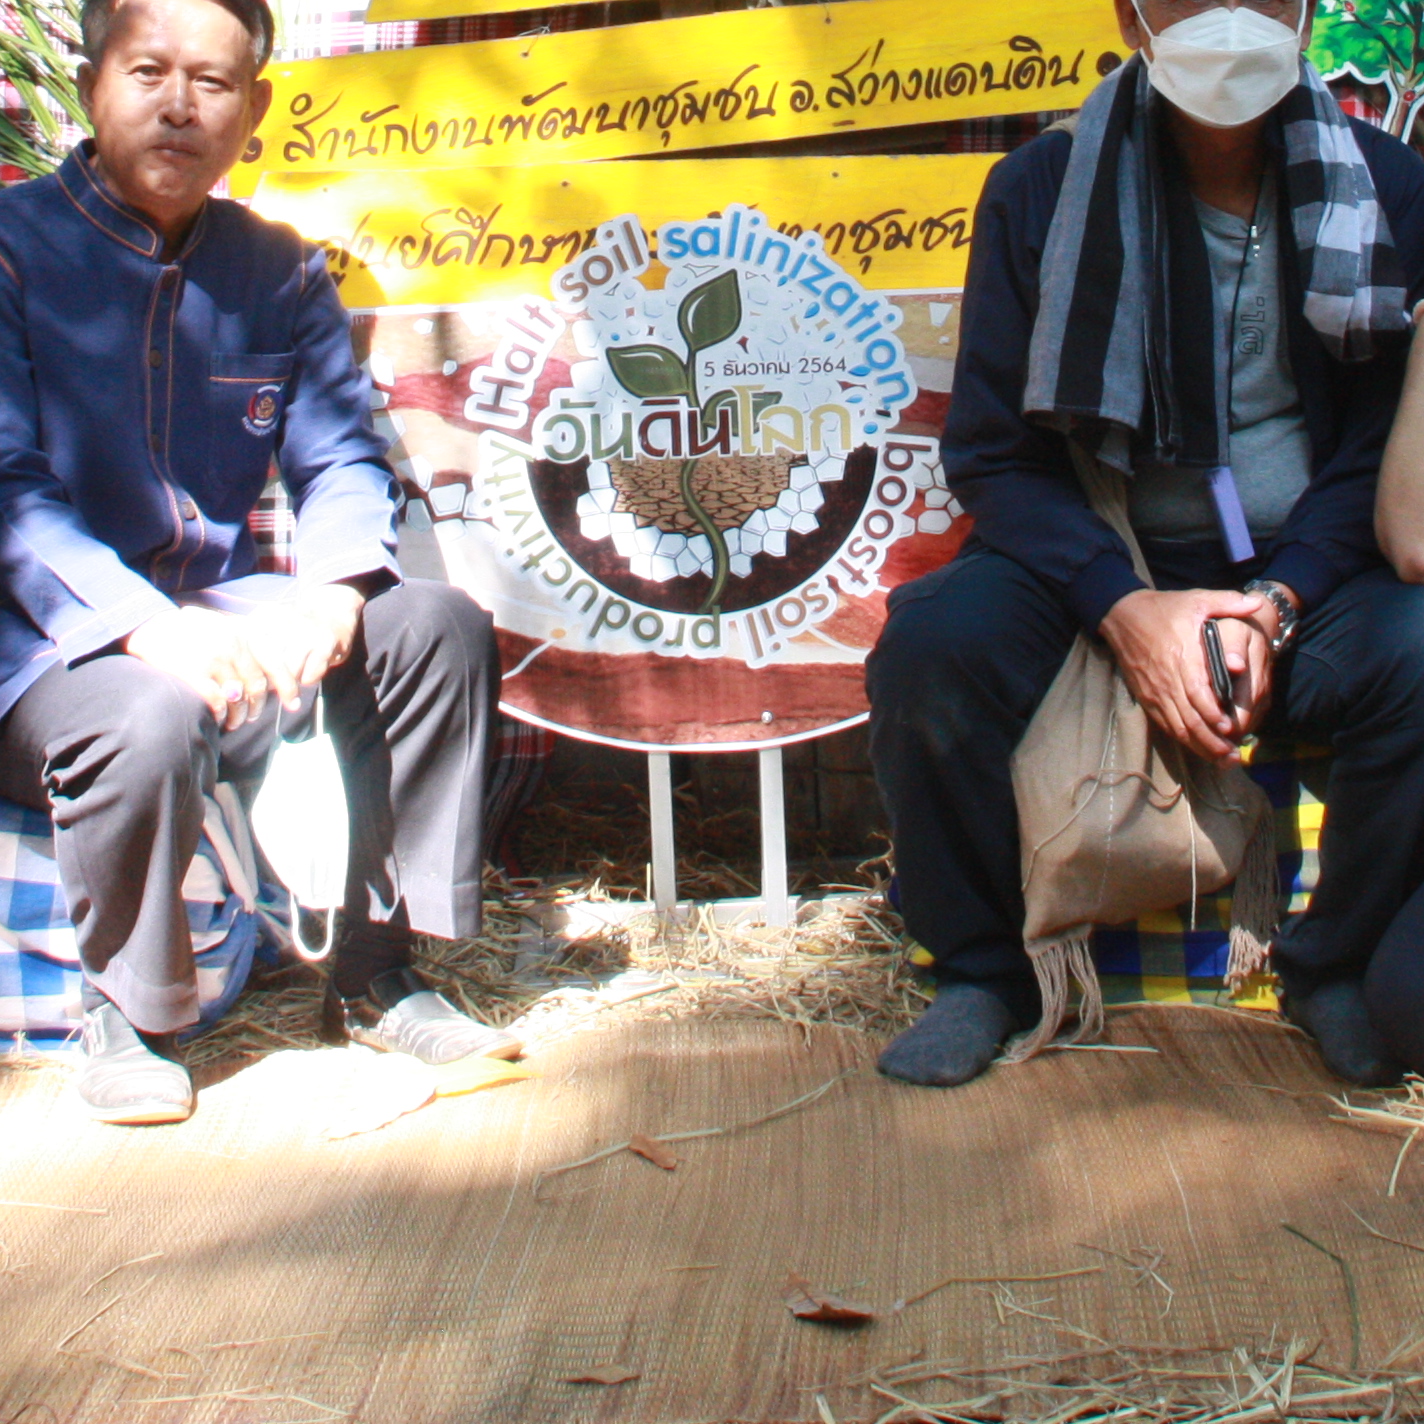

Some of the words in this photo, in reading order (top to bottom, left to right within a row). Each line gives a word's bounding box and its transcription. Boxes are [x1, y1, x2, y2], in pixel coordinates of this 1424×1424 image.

[282, 76, 776, 163] สำนักงานพัฒนาชุมชน
[790, 34, 1084, 114] อ.สว่างแดนดิน
[476, 304, 556, 418] Halt
[560, 221, 644, 303] soil
[704, 361, 715, 376] 5
[723, 360, 790, 376] ธันวาคม
[798, 357, 846, 374] 2564
[542, 384, 852, 462] วันดินโลก
[483, 441, 721, 649] productivity
[843, 441, 934, 585] boost
[748, 581, 830, 660] soil
